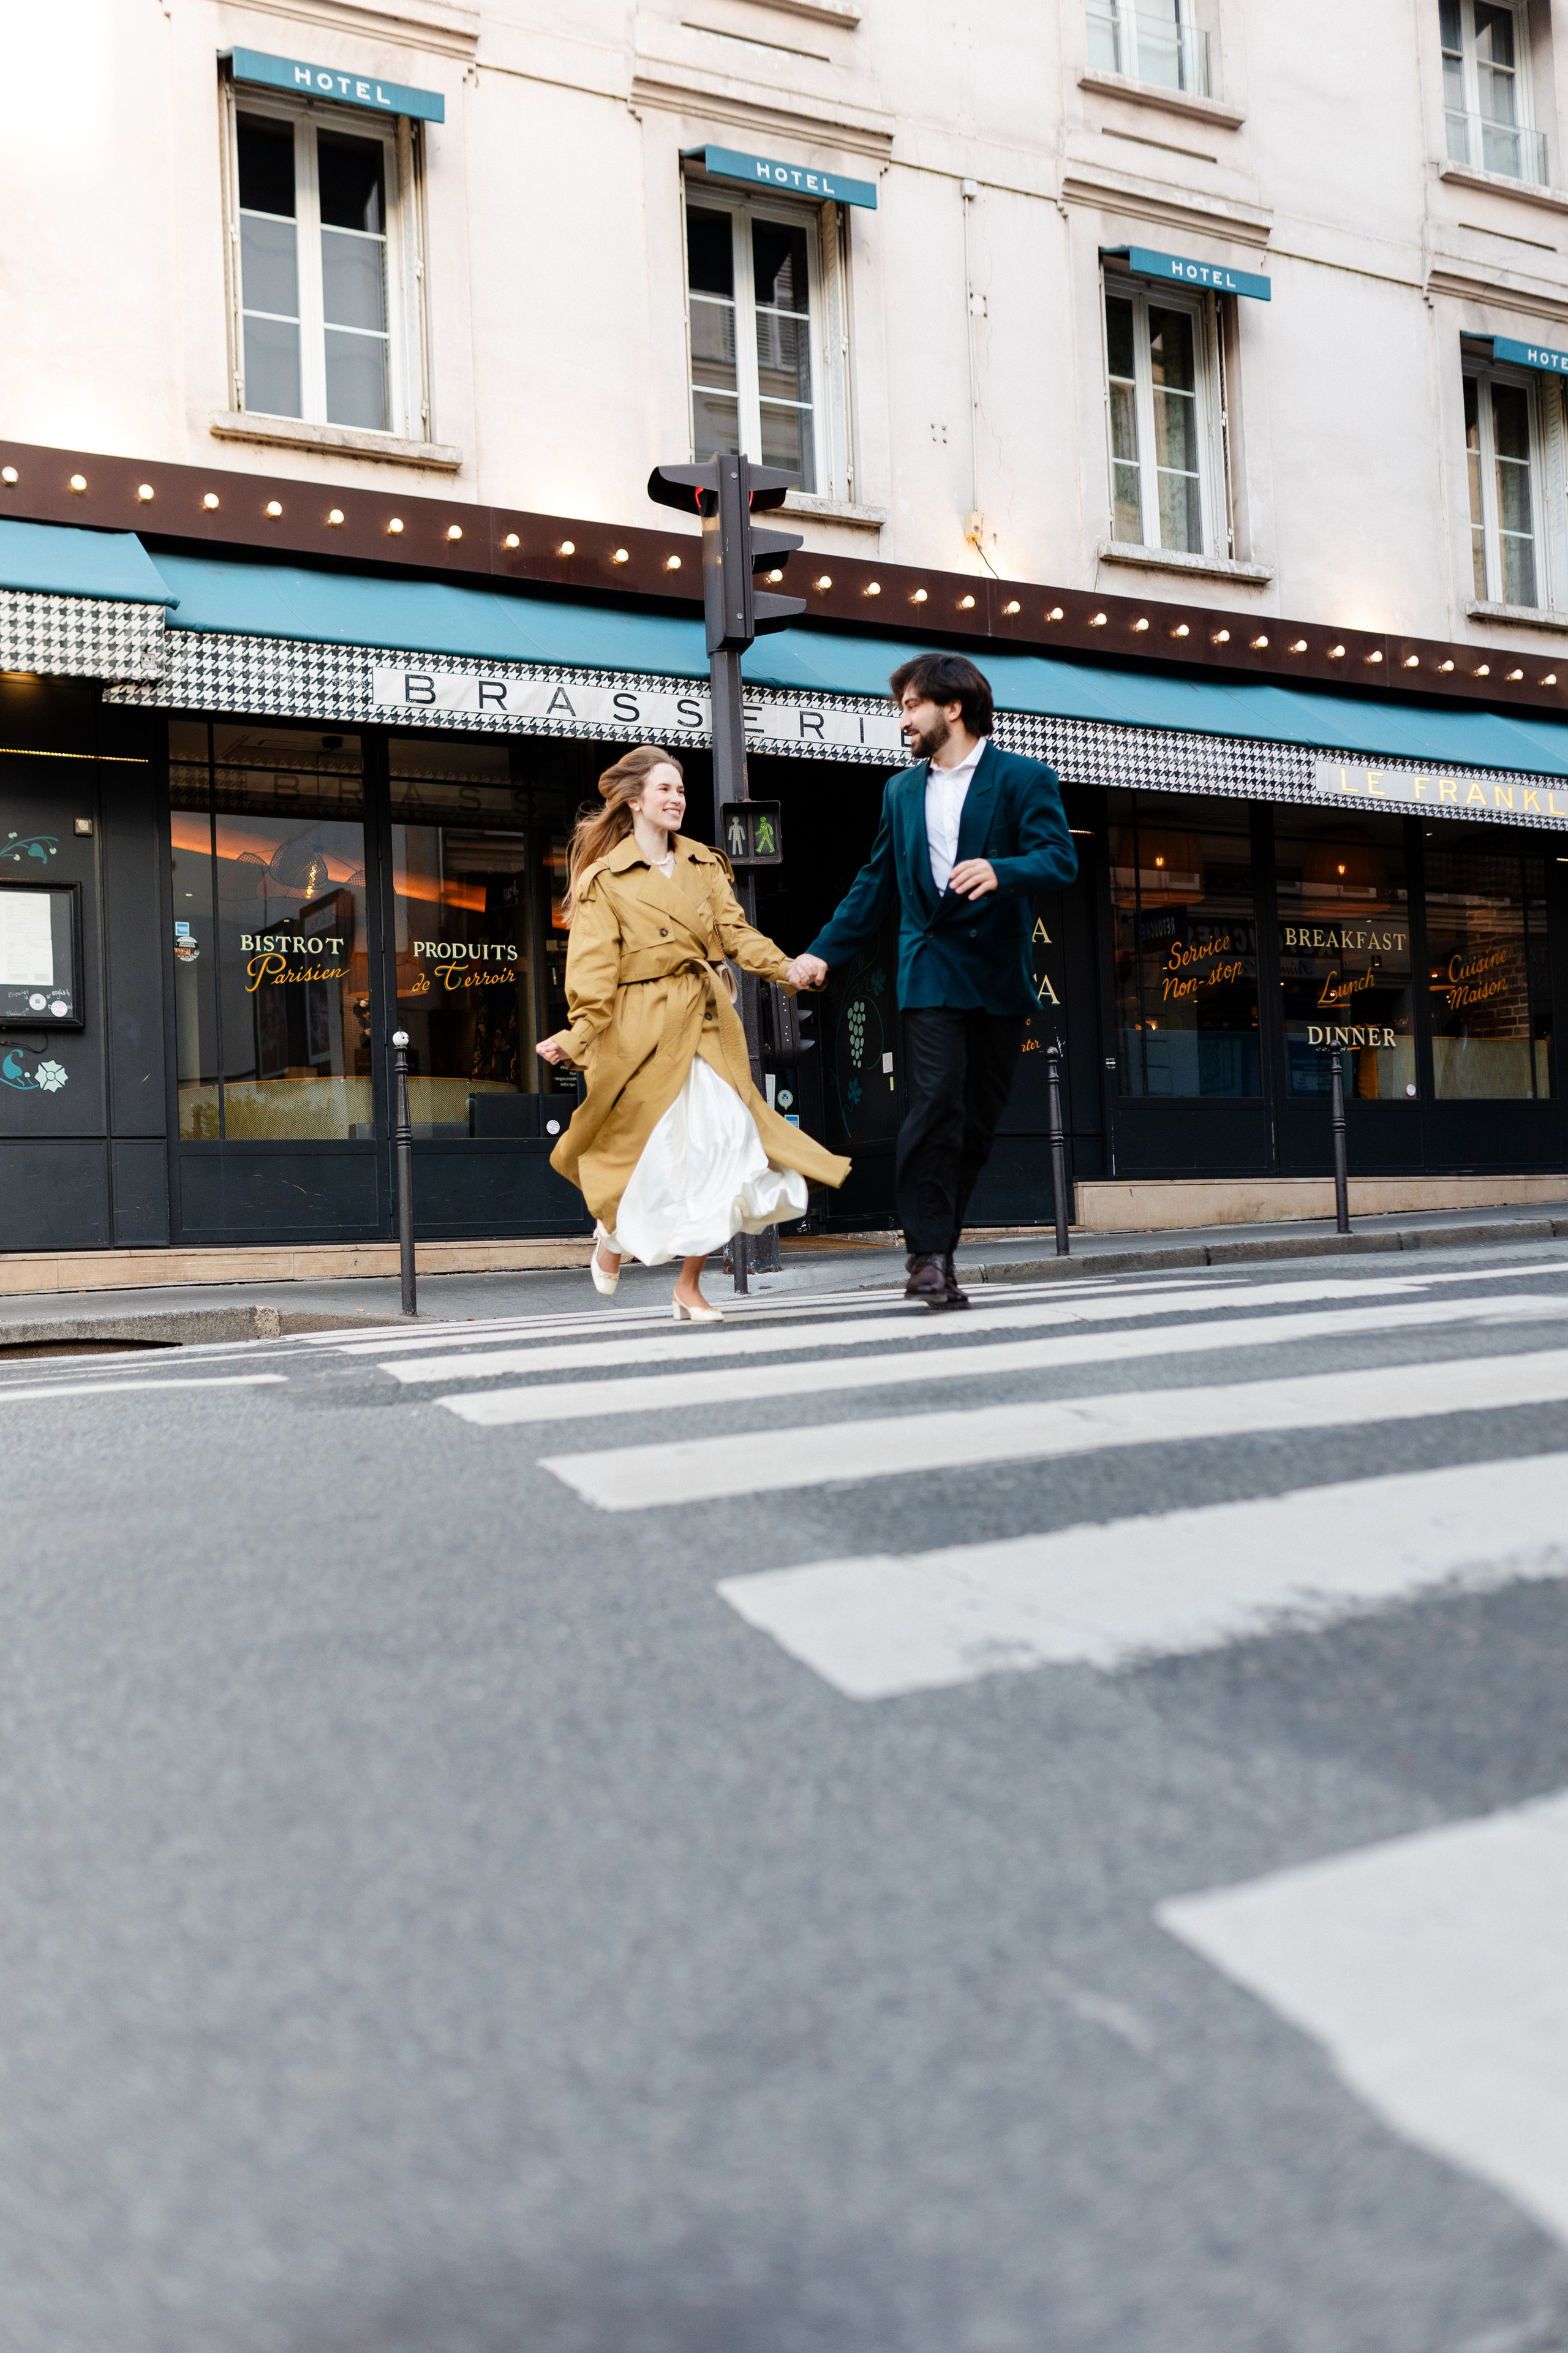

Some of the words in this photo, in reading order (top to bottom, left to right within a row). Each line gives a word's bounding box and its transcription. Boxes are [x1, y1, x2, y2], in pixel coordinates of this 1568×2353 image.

[294, 66, 391, 105] HOTEL
[756, 162, 835, 195] HOTEL
[1171, 260, 1236, 289] HOTEL
[1340, 767, 1386, 796] LE
[1414, 776, 1566, 816] FRANKL
[240, 934, 344, 955] BISTROT
[413, 942, 518, 961] PRODUITS
[1169, 935, 1230, 970] Service
[1285, 927, 1406, 950] BREAKFAST
[245, 953, 350, 992] Parisien
[410, 973, 430, 994] de
[434, 961, 518, 991] Terroir
[1162, 962, 1243, 1001] Non-stop
[1449, 950, 1506, 983] Cuisine
[1317, 967, 1375, 1004] Lunch
[1449, 978, 1509, 1010] Maison
[1306, 1026, 1396, 1047] DINNER
